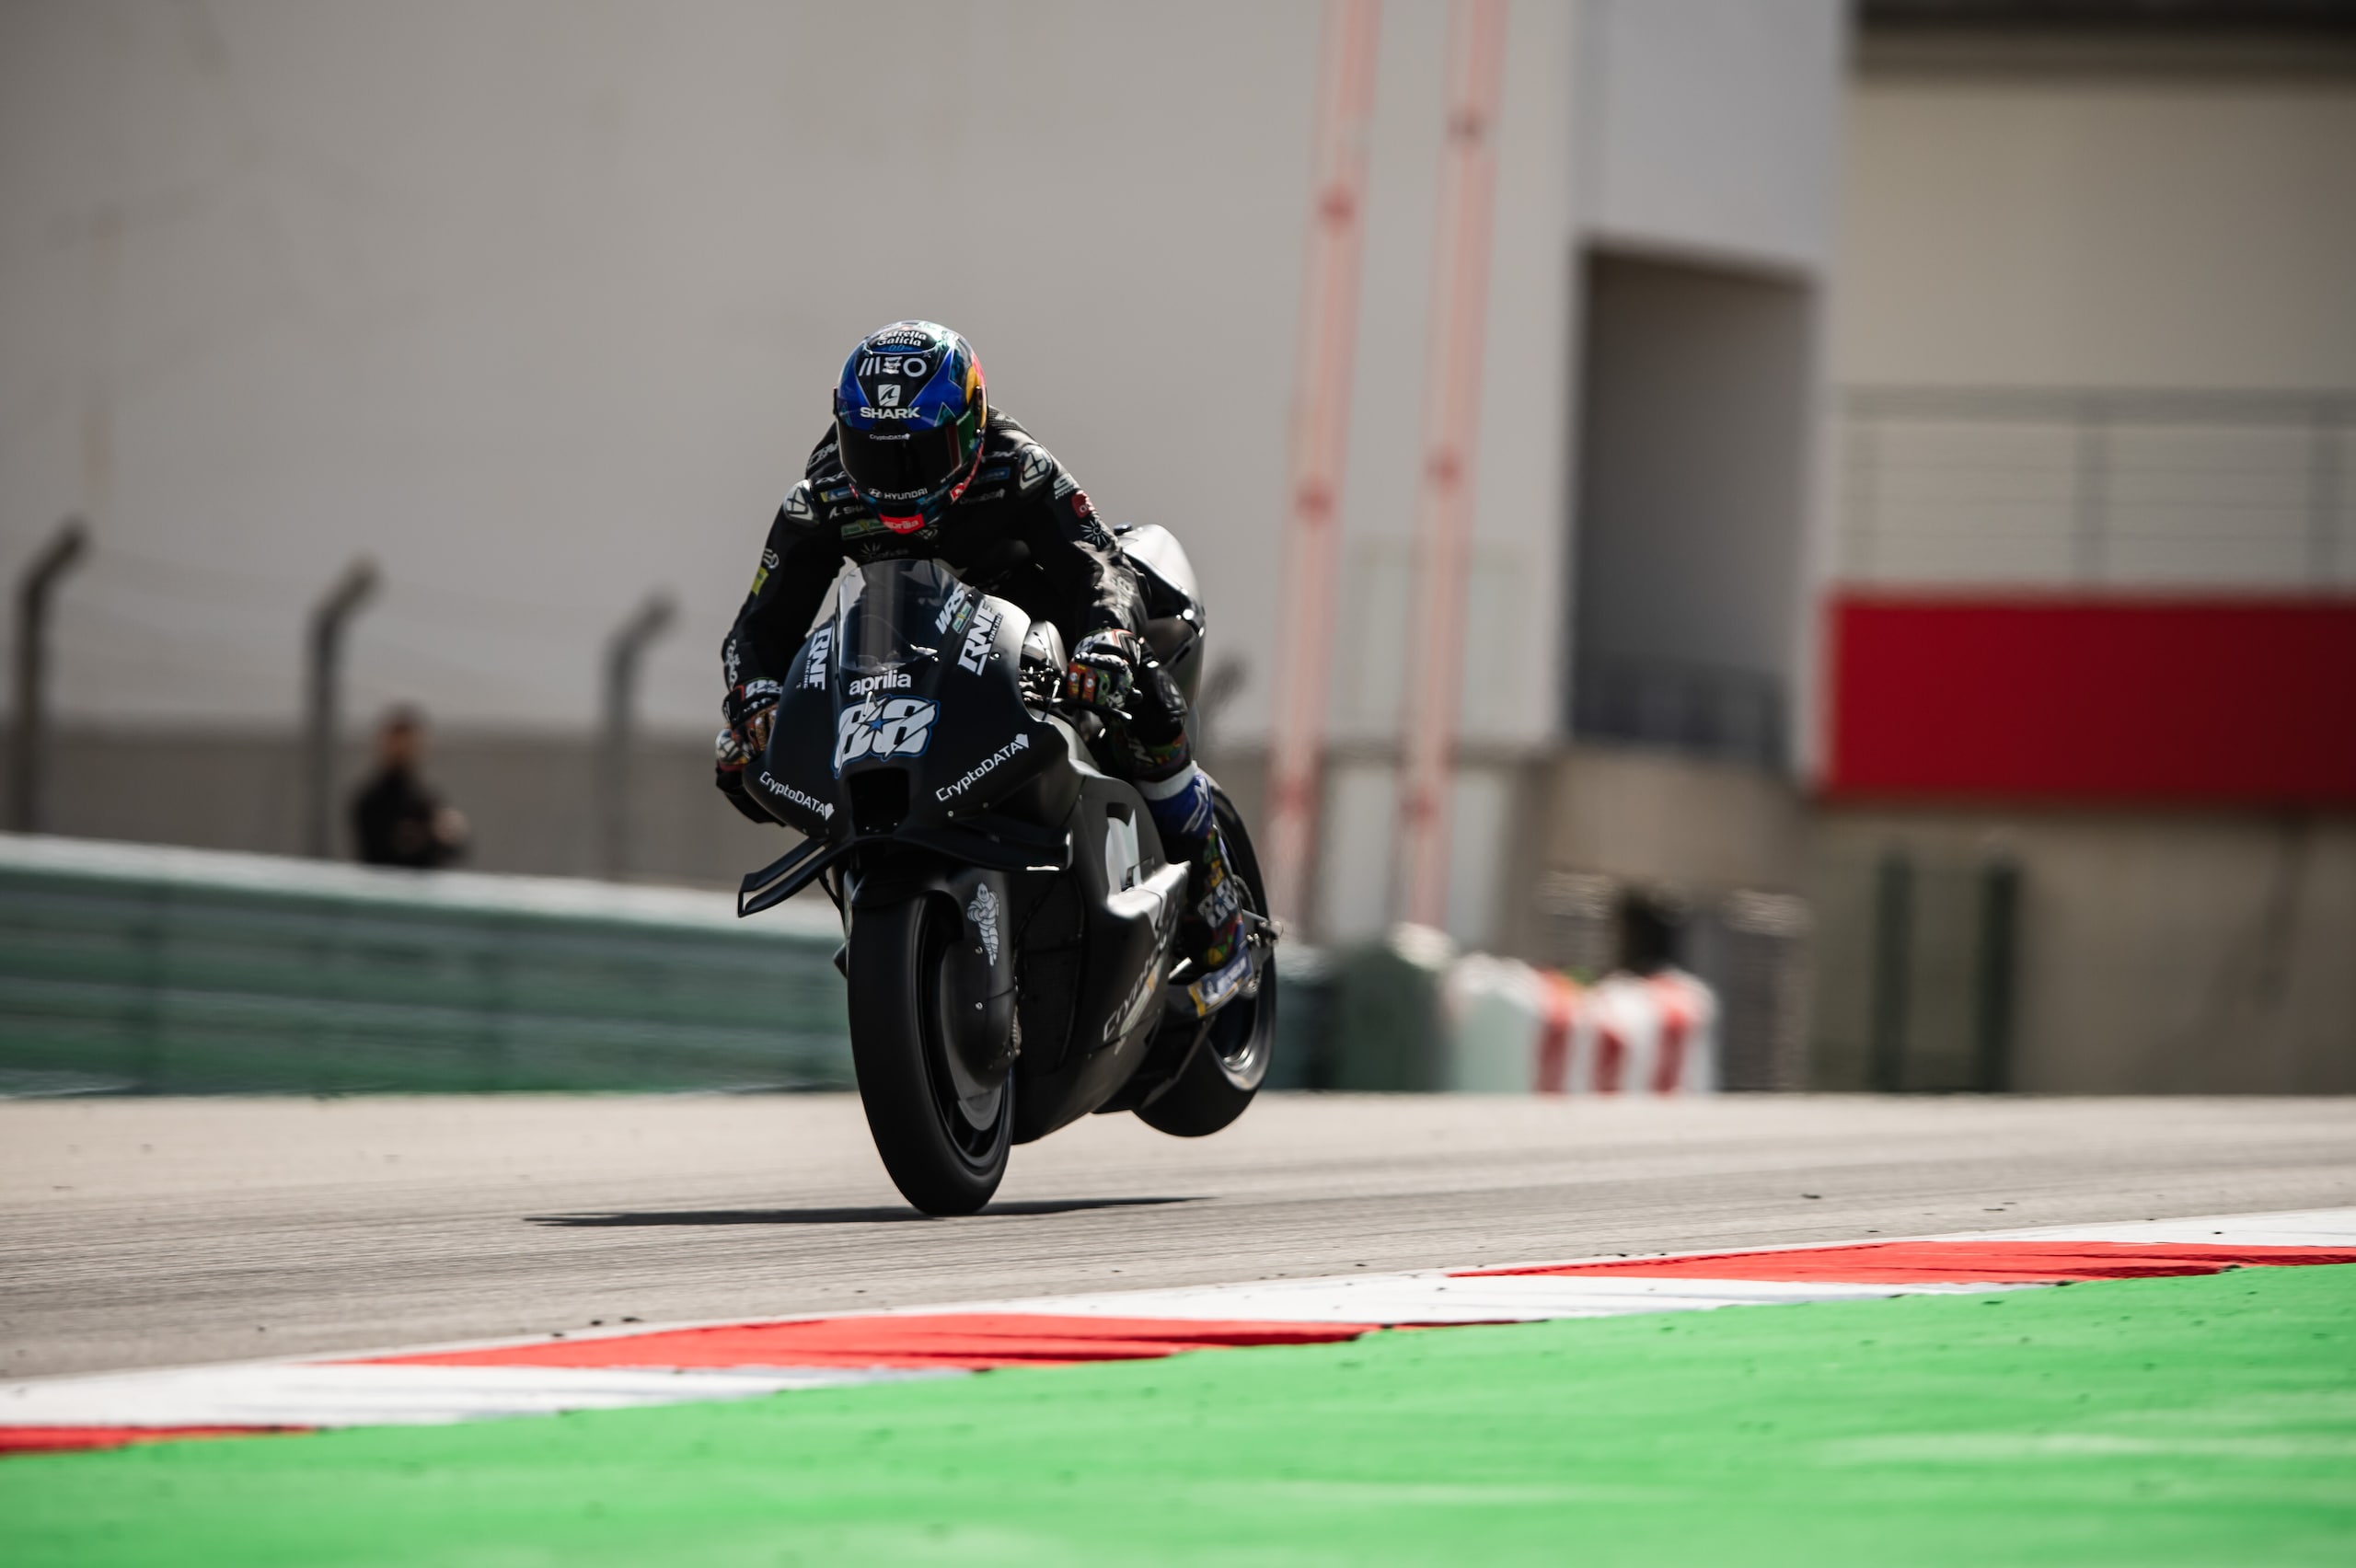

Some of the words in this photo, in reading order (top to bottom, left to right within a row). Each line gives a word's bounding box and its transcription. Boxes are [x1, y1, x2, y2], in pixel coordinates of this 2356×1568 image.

[877, 337, 922, 347] Galicia
[878, 329, 927, 340] Estrella
[860, 407, 920, 420] SHARK
[884, 488, 929, 501] HYUNDAI
[935, 582, 966, 635] WRS
[808, 627, 833, 690] RNF
[957, 599, 999, 676] RNF
[849, 669, 912, 696] aprilia
[833, 696, 937, 775] 88
[935, 740, 1024, 801] CryptoDATA
[759, 771, 827, 816] CryptoDATA
